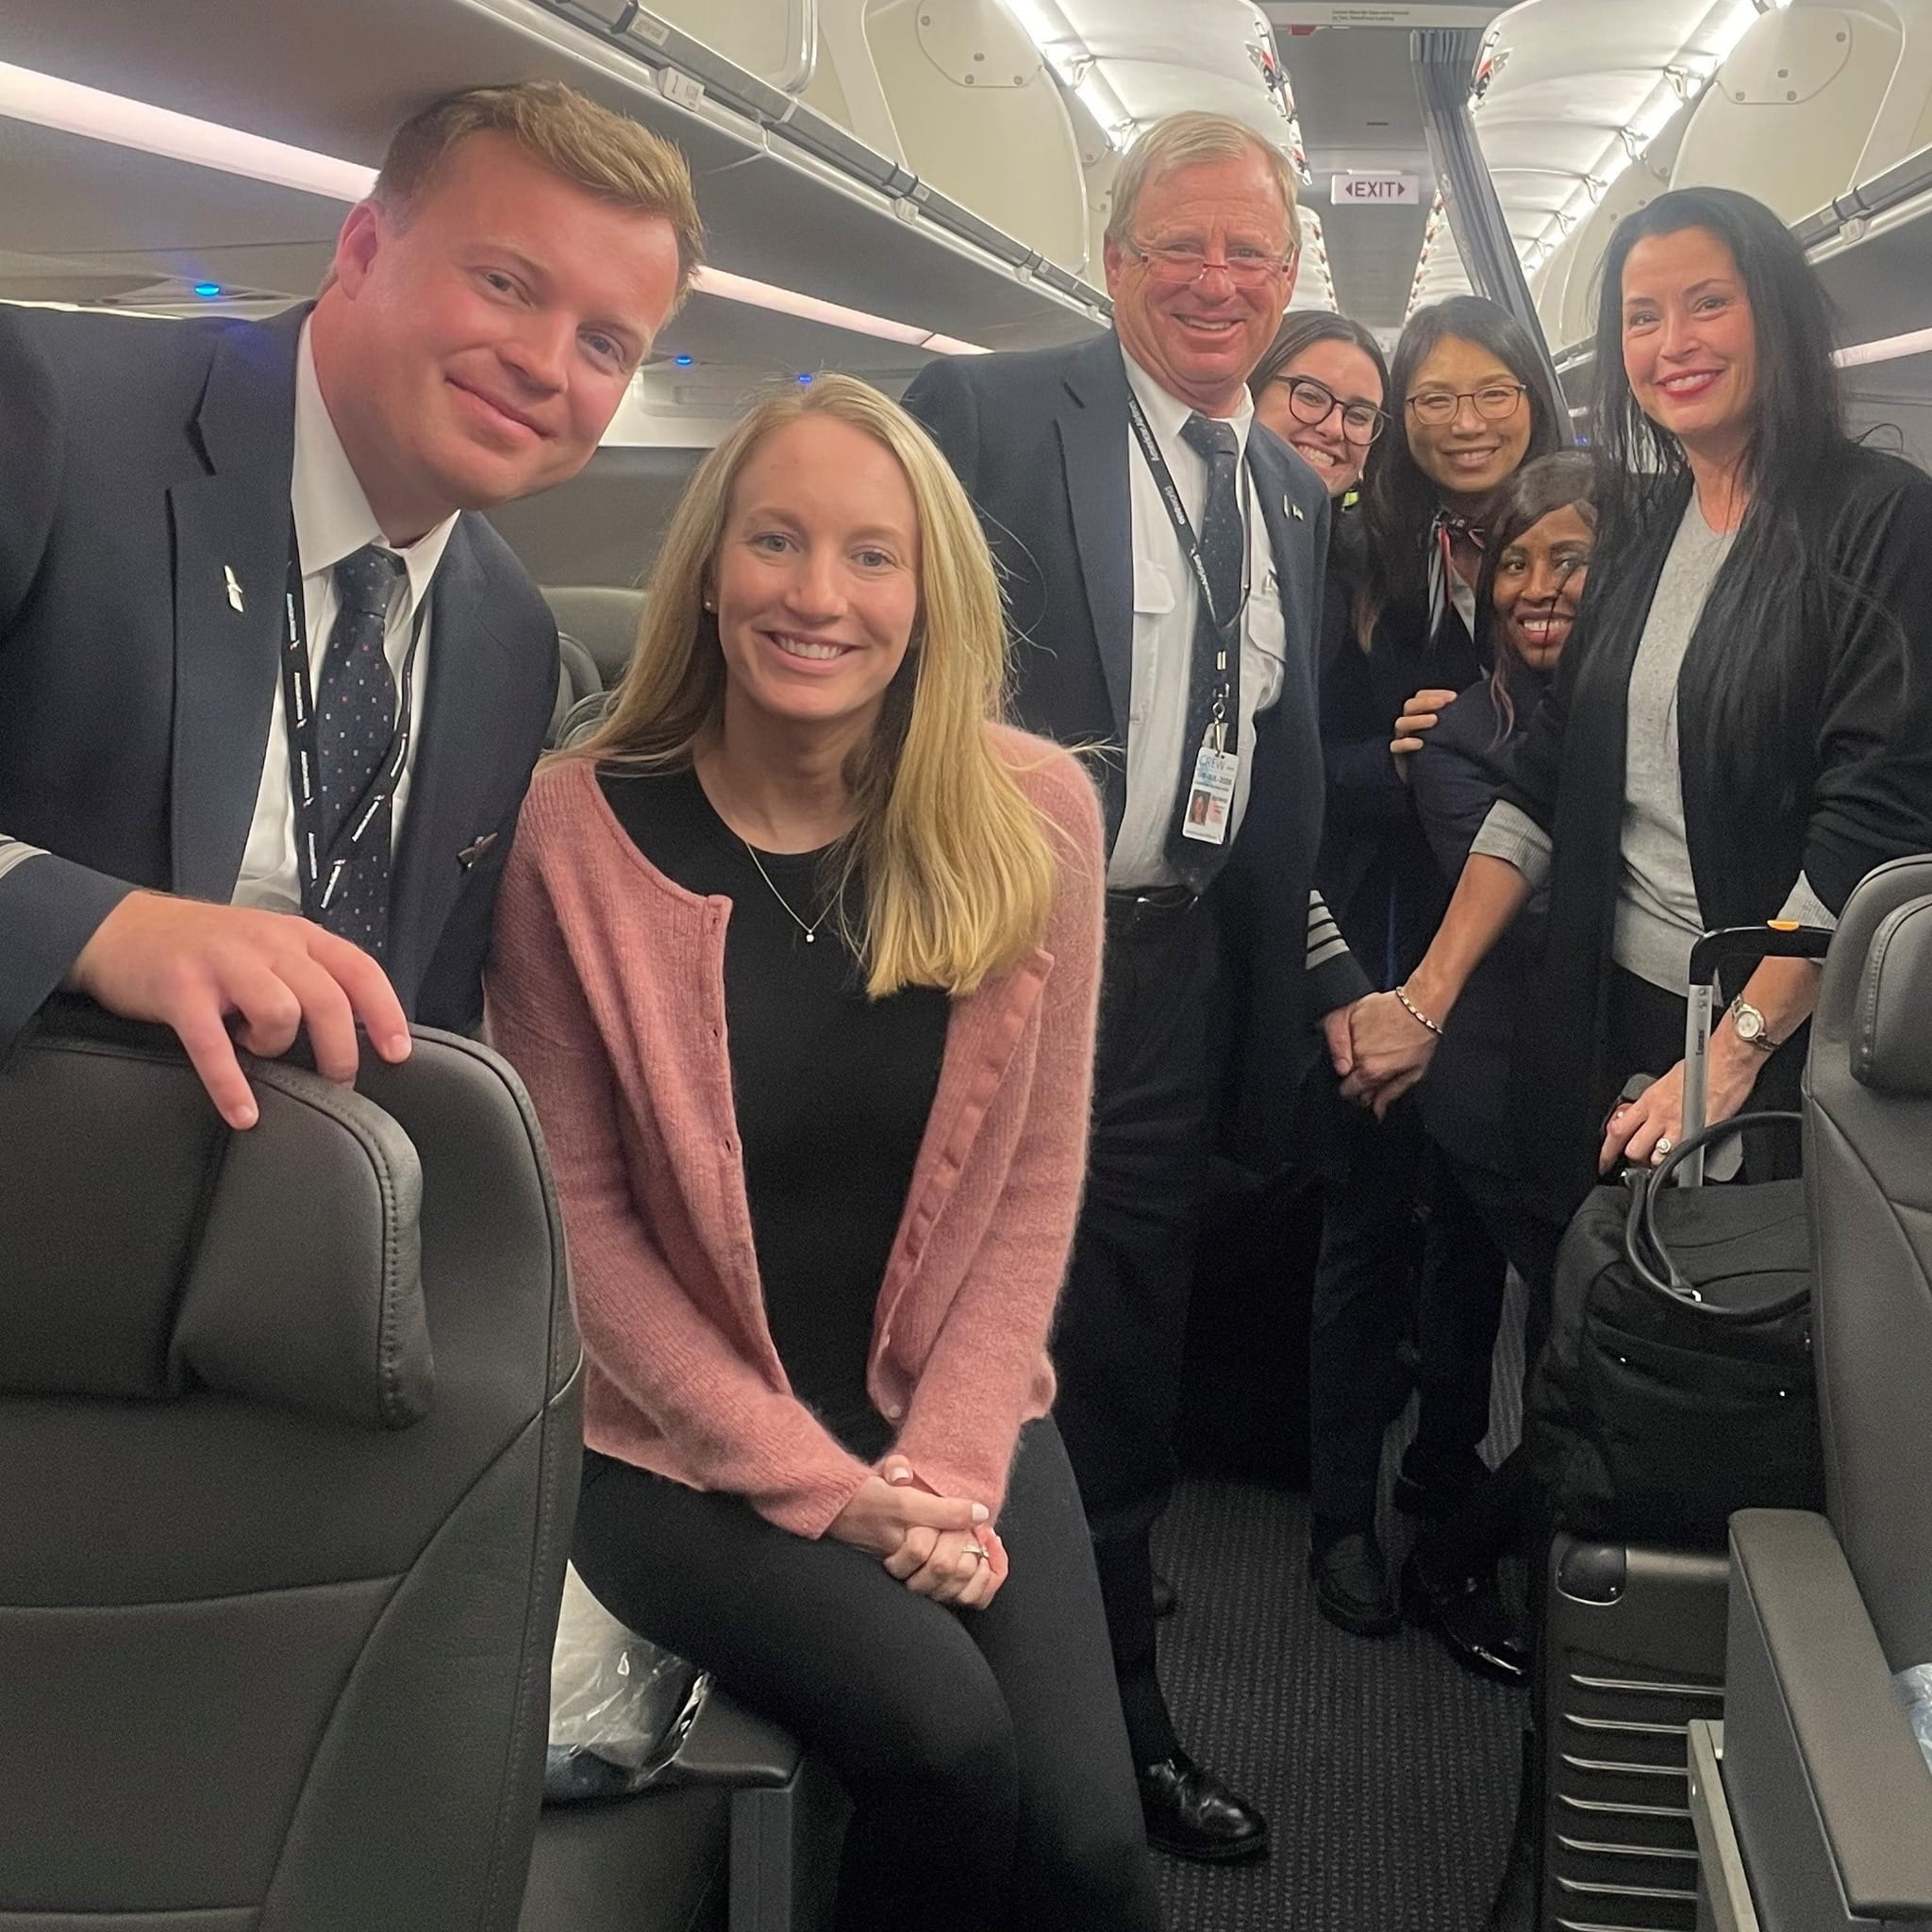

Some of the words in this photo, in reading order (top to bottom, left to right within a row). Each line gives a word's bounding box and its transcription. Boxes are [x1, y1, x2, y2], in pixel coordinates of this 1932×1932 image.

[1355, 181, 1396, 197] EXIT
[1164, 485, 1186, 525] oneworld
[1199, 755, 1225, 771] CREW
